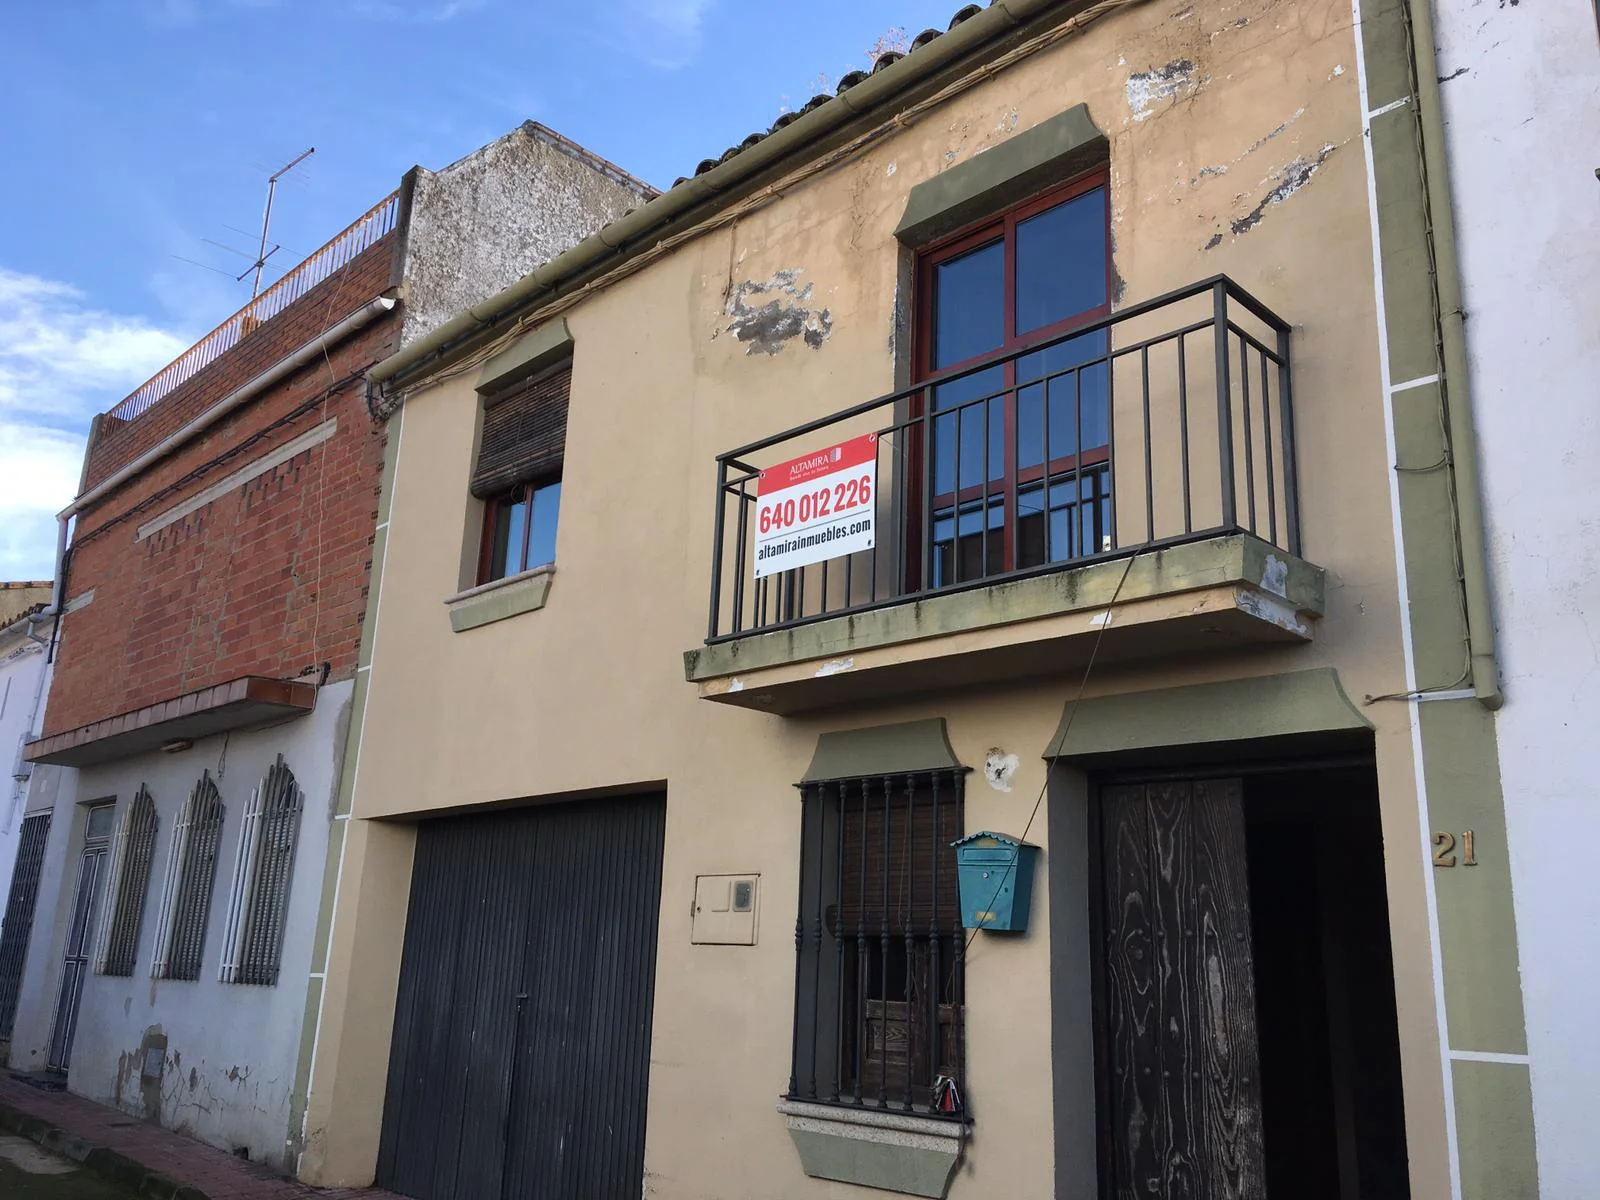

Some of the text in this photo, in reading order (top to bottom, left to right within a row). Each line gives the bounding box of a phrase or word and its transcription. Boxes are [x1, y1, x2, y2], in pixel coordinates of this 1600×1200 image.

[790, 455, 829, 474] ALTAMIRA
[760, 475, 871, 533] 640 012 226
[759, 519, 871, 560] altamirainmuebles.com
[1432, 830, 1478, 867] 21
